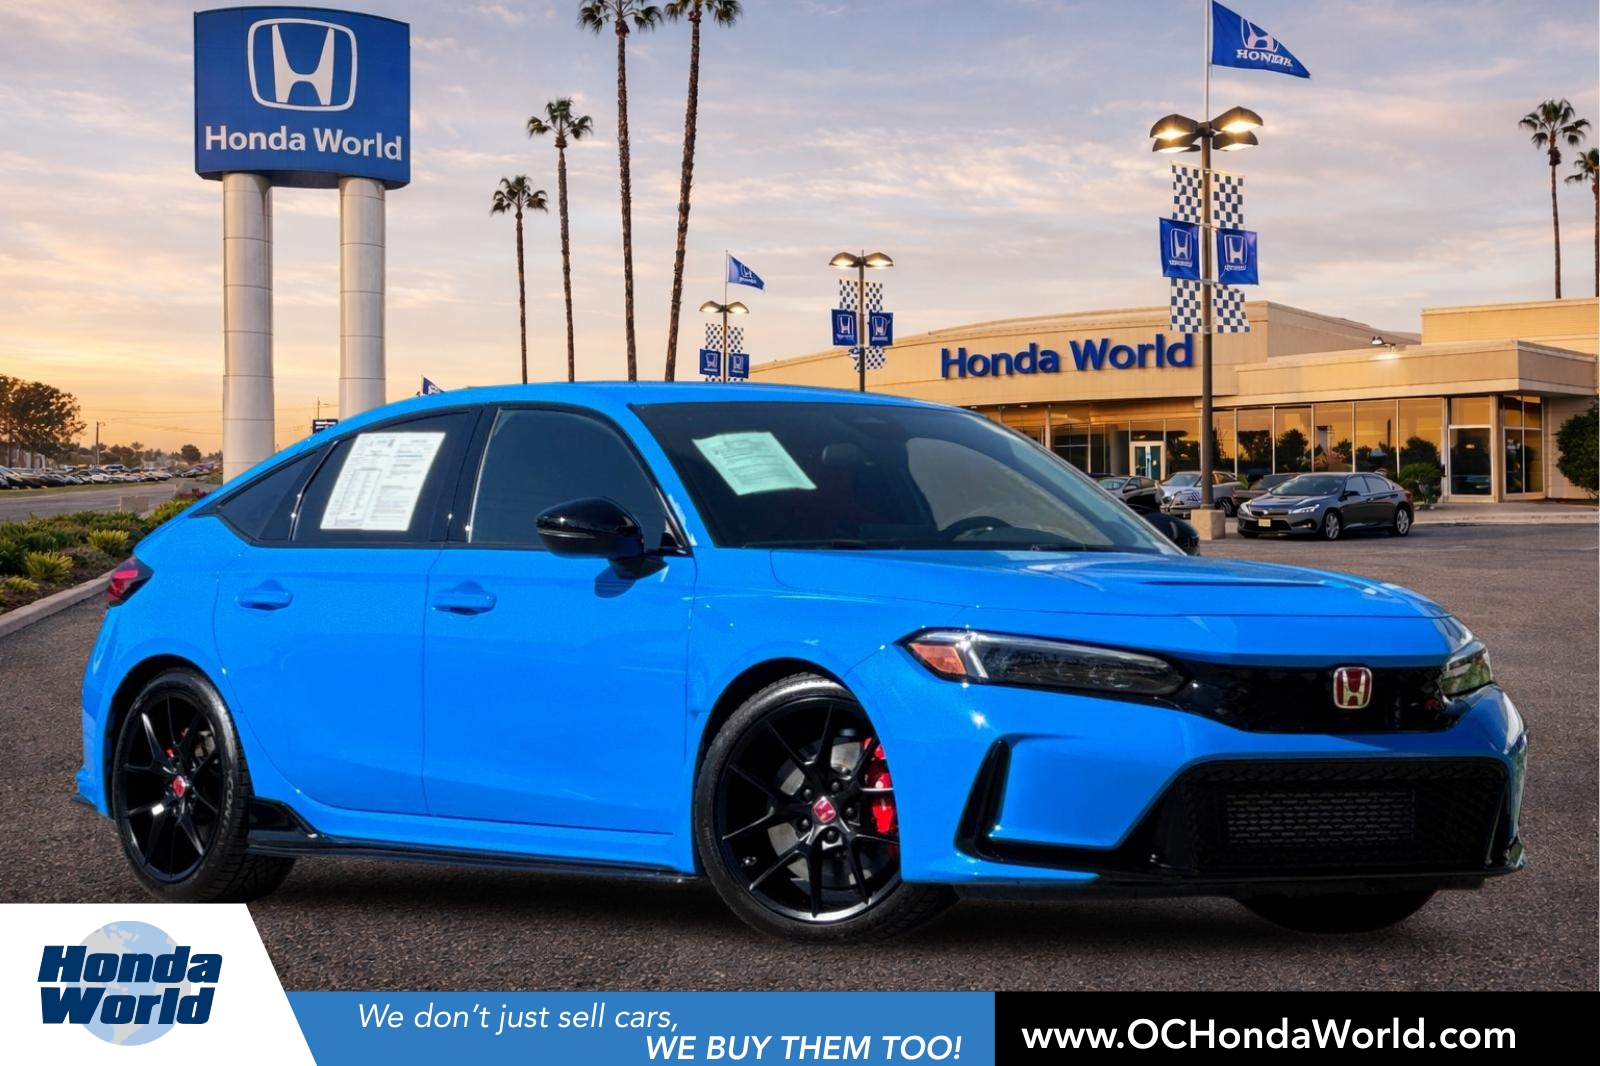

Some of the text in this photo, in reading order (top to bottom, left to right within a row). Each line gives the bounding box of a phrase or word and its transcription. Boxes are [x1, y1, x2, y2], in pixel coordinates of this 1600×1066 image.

[205, 125, 402, 161] Honda World
[941, 333, 1194, 379] Honda World
